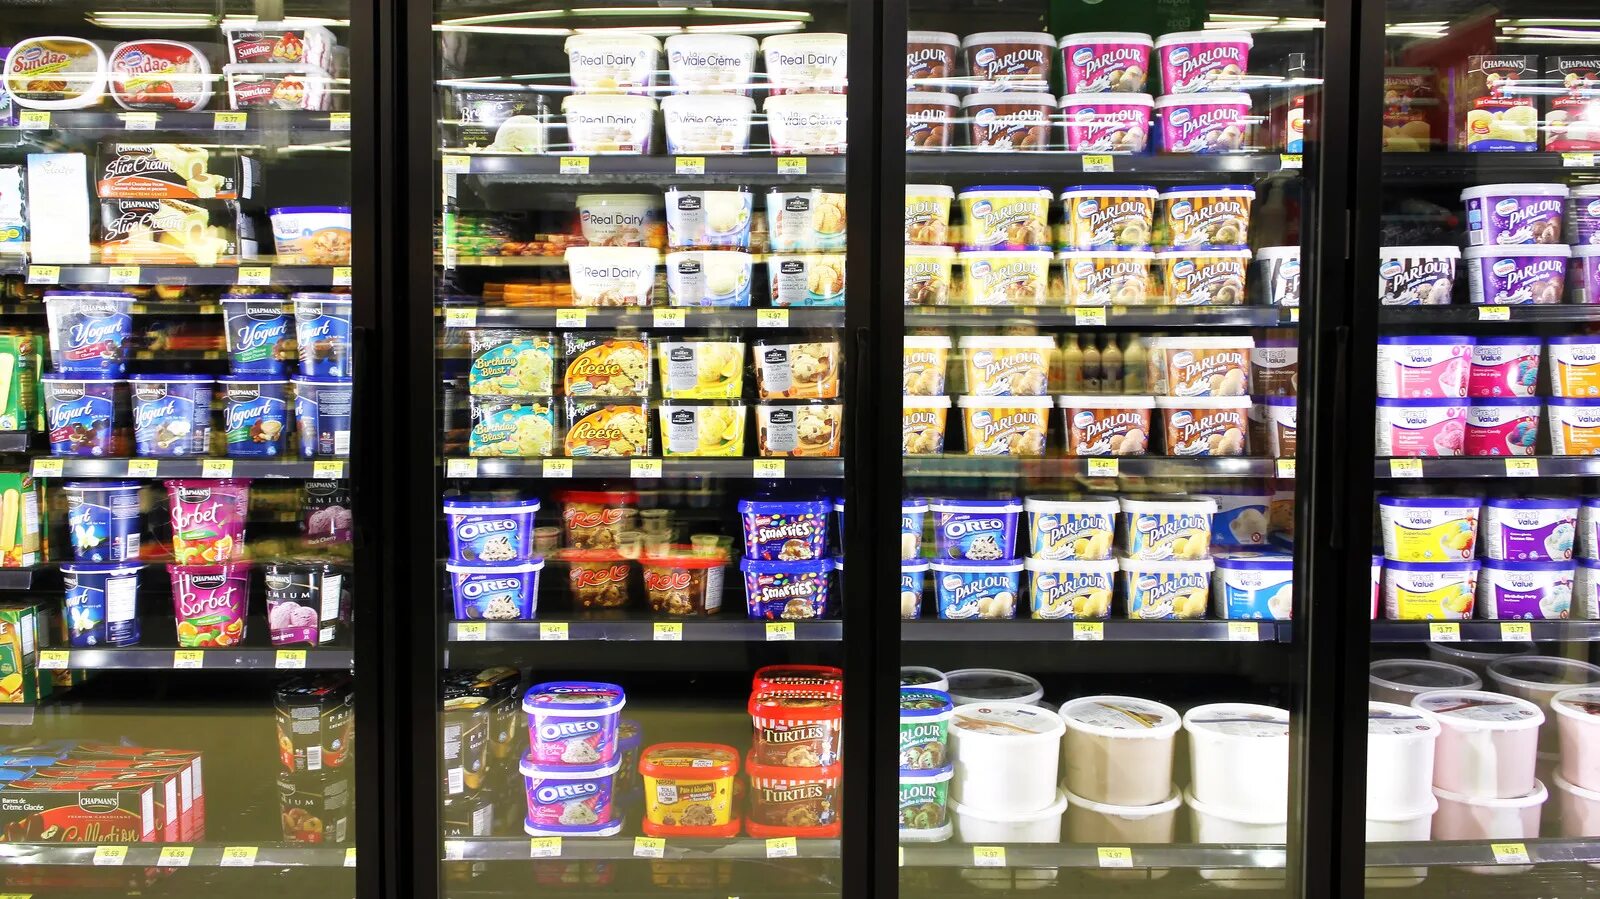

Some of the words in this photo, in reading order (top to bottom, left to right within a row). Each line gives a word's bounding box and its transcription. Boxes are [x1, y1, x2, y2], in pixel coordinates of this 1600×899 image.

[13, 51, 67, 72] Sundae
[238, 44, 271, 58] Sundae
[580, 55, 604, 66] Real
[606, 54, 636, 67] Dairy
[682, 55, 706, 66] Vraie
[707, 54, 741, 66] Crème
[780, 53, 805, 66] Real
[808, 53, 838, 67] Dairy
[907, 49, 946, 64] RLOUR
[988, 49, 1044, 79] PARLOUR
[1085, 48, 1142, 79] PARLOUR
[1181, 47, 1239, 78] PARLOUR
[1482, 60, 1524, 69] CHAPMAN'S
[1560, 60, 1600, 69] CHAPMAN'S
[238, 87, 271, 98] Sundae
[906, 109, 946, 127] RLOUR
[988, 109, 1044, 140] PARLOUR
[1087, 109, 1143, 139] PARLOUR
[1182, 108, 1239, 139] PARLOUR
[103, 155, 133, 180] Slice
[132, 153, 174, 173] Cream
[120, 200, 160, 210] CHAPMAN'S
[984, 202, 1039, 229] PARLOUR
[1509, 200, 1561, 230] PARLOUR
[104, 212, 137, 241] Slice
[590, 214, 611, 225] Real
[614, 214, 644, 226] Dairy
[1090, 202, 1145, 231] PARLOUR
[1184, 201, 1241, 232] PARLOUR
[584, 266, 609, 278] Real
[612, 266, 641, 279] Dairy
[983, 262, 1039, 288] PARLOUR
[1086, 262, 1143, 292] PARLOUR
[1186, 262, 1241, 291] PARLOUR
[1393, 262, 1449, 292] PARLOUR
[1507, 260, 1562, 290] PARLOUR
[68, 318, 122, 348] Yogurt
[236, 320, 287, 351] Yogurt
[471, 338, 501, 354] Breyers
[566, 338, 596, 355] Breyers
[475, 356, 518, 370] Birthday
[481, 366, 506, 378] Blast
[572, 357, 620, 376] Reese
[985, 352, 1041, 381] PARLOUR
[1186, 352, 1242, 381] PARLOUR
[53, 388, 84, 396] CHAPMAN'S
[49, 401, 92, 430] Yogurt
[134, 401, 174, 430] Yogurt
[223, 400, 271, 432] Yogourt
[471, 404, 501, 419] Breyers
[566, 403, 597, 419] Breyers
[475, 422, 518, 435] Birthday
[573, 422, 621, 440] Reese
[984, 411, 1040, 441] PARLOUR
[1086, 413, 1142, 441] PARLOUR
[1185, 412, 1240, 441] PARLOUR
[481, 432, 506, 443] Blast
[171, 502, 224, 531] Sorbet
[459, 519, 517, 540] OREO
[758, 522, 811, 543] SMARTIES
[946, 519, 1003, 539] OREO
[1050, 517, 1107, 545] PARLOUR
[1149, 517, 1205, 546] PARLOUR
[192, 574, 225, 583] CHAPMAN'S
[462, 578, 520, 599] OREO
[180, 586, 237, 616] Sorbet
[761, 581, 814, 601] SMARTIES
[955, 576, 1010, 605] PARLOUR
[1049, 576, 1105, 605] PARLOUR
[1149, 576, 1205, 605] PARLOUR
[541, 721, 599, 740] OREO
[764, 727, 824, 742] TURTLES
[900, 725, 940, 742] RLOUR
[80, 798, 118, 806] CHAPMAN'S
[538, 783, 596, 802] OREO
[763, 786, 823, 801] TURTLES
[2, 803, 22, 811] Crème
[23, 803, 45, 811] Glacée
